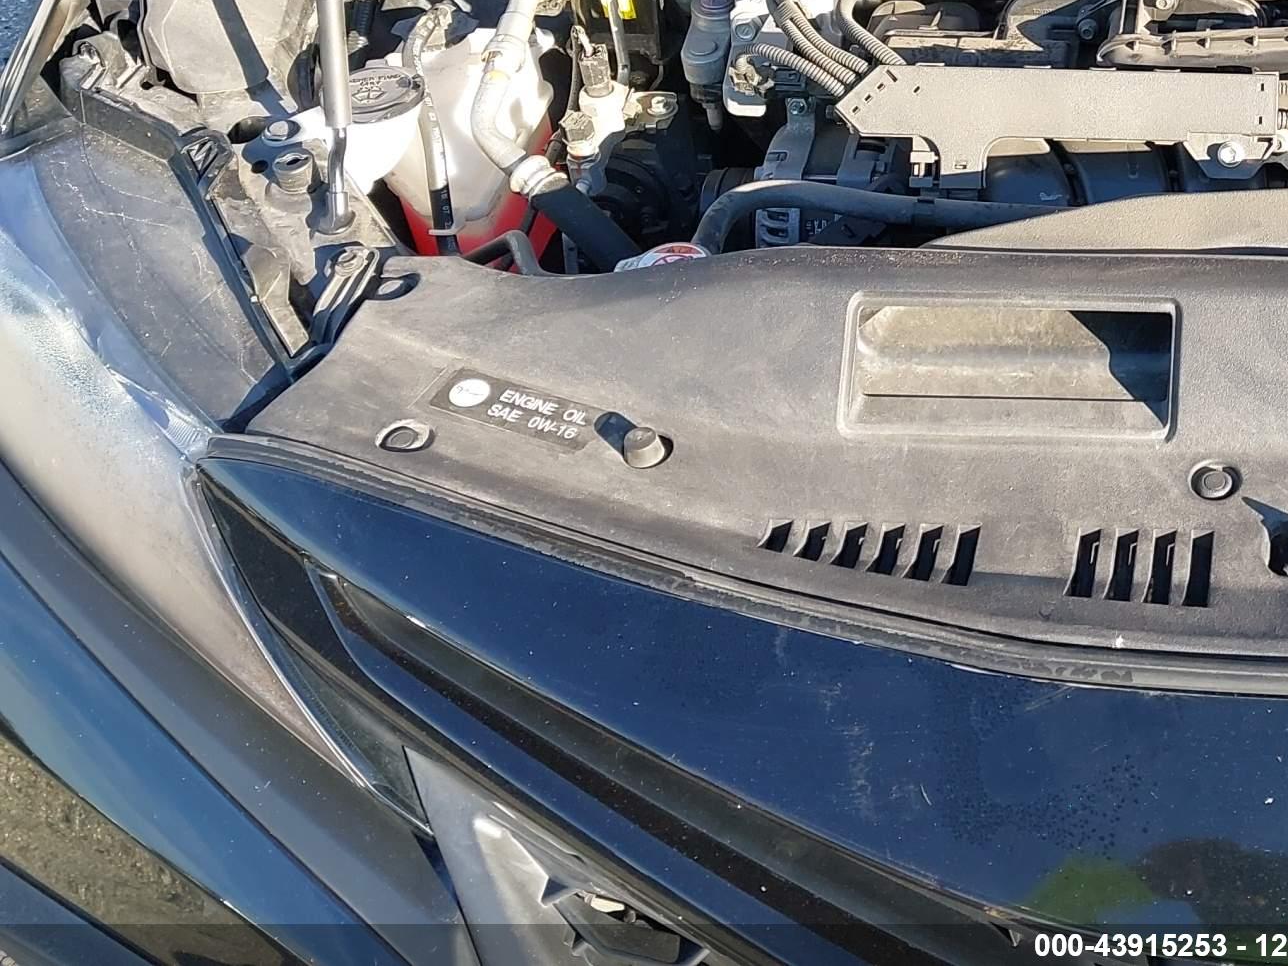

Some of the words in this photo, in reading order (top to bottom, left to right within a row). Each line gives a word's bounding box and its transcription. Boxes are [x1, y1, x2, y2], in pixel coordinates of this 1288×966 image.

[487, 403, 524, 423] SAE
[527, 416, 578, 439] 0W-16
[499, 389, 560, 416] ENGINE
[562, 409, 587, 426] OIL
